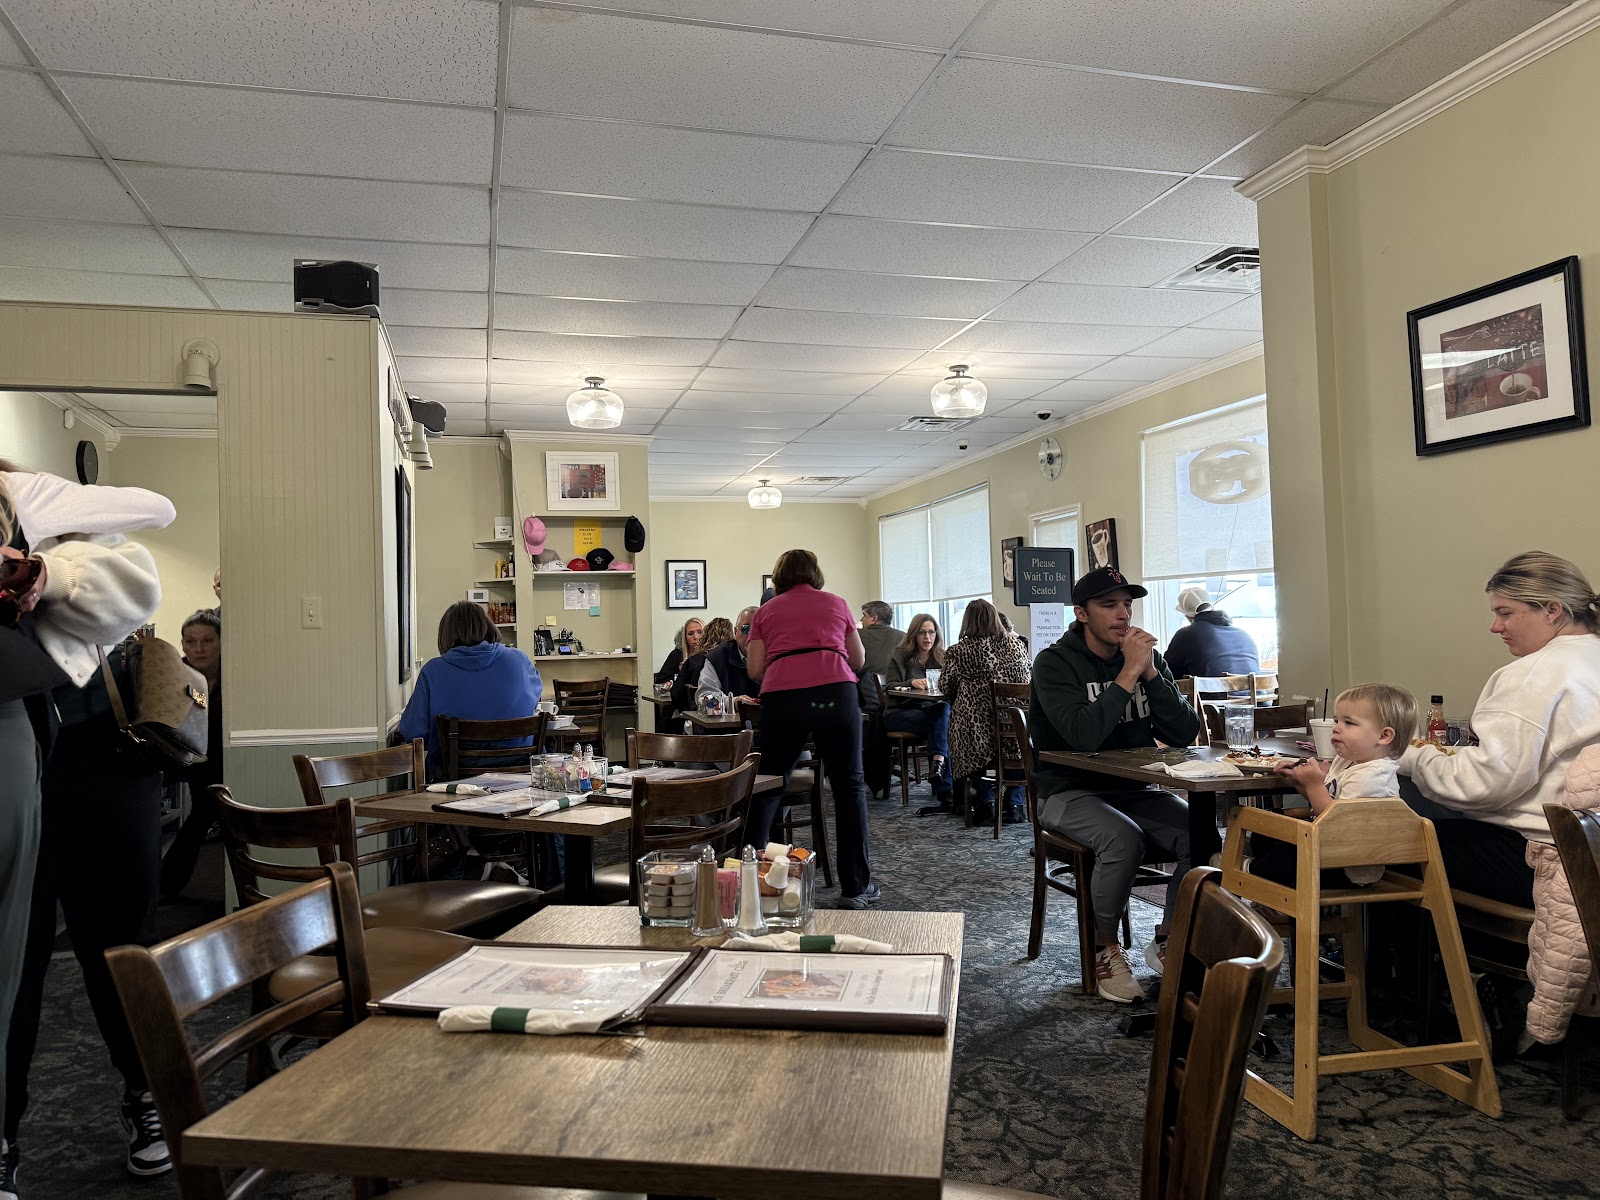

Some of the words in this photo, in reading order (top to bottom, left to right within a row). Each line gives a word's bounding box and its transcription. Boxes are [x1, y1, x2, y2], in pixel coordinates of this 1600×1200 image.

[1487, 340, 1541, 368] LATTE
[1031, 557, 1056, 568] Please
[1023, 571, 1042, 581] Wait
[1043, 571, 1054, 582] To
[1055, 572, 1067, 582] Be
[1031, 585, 1057, 595] Seated
